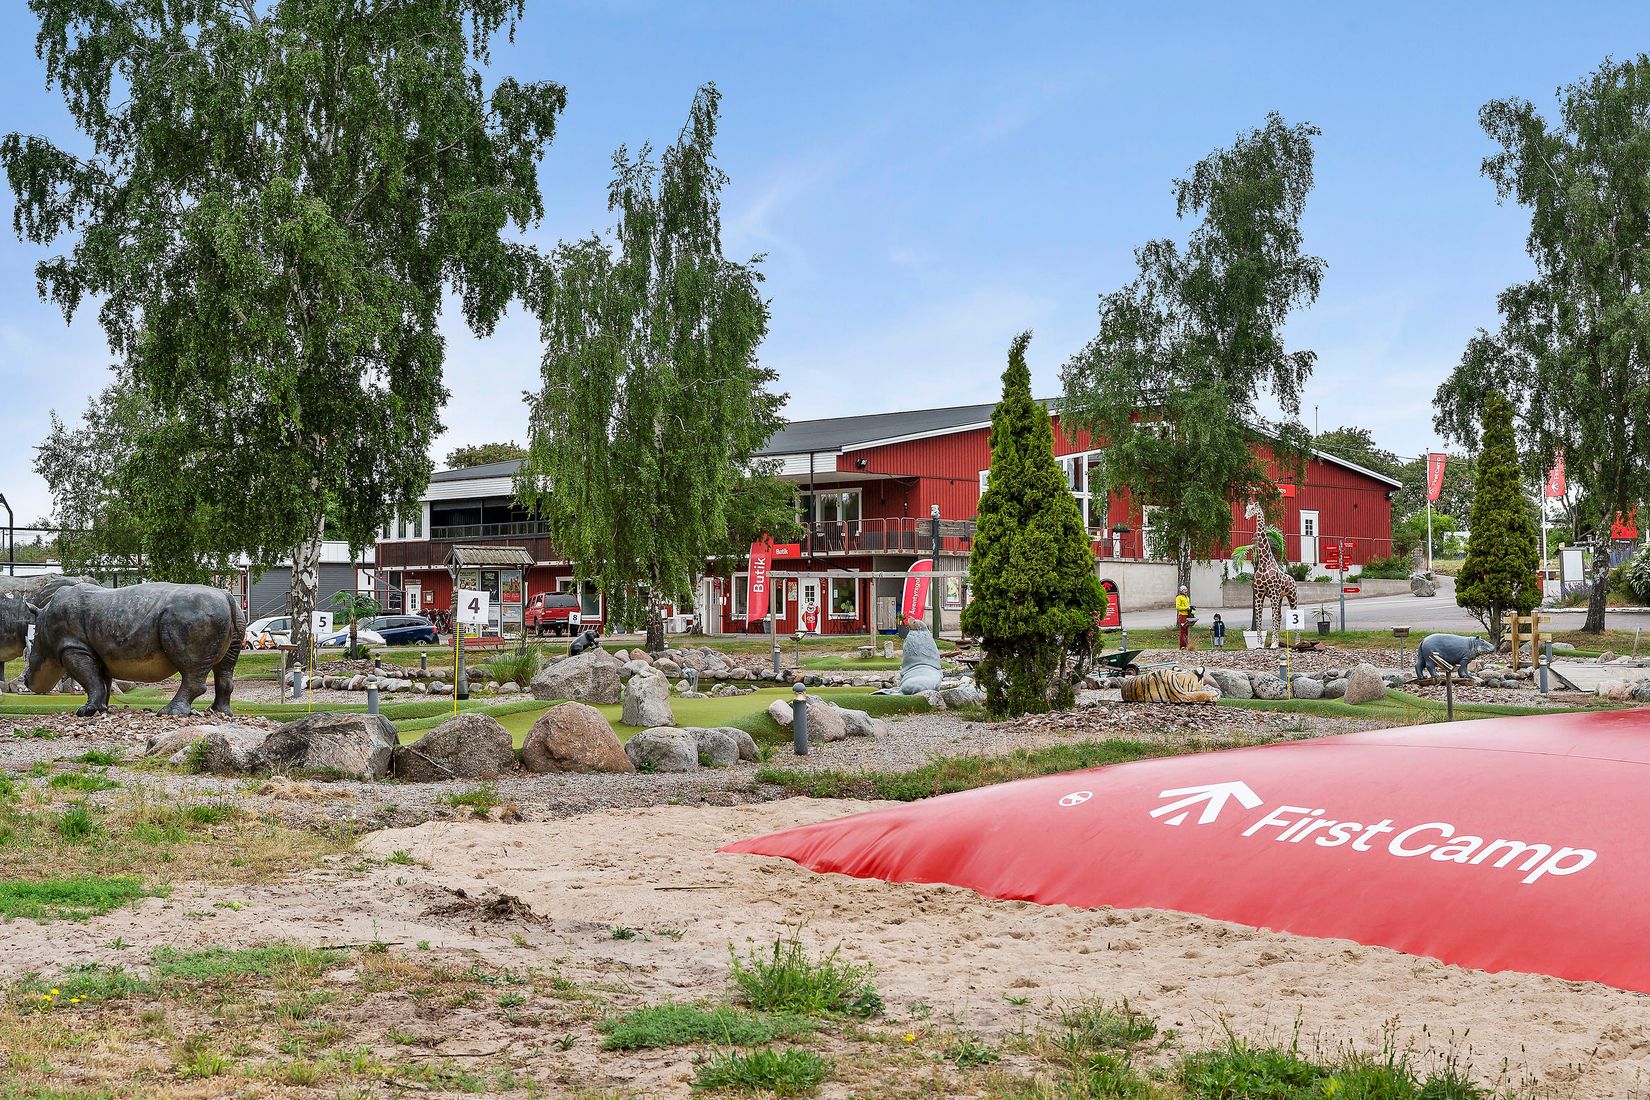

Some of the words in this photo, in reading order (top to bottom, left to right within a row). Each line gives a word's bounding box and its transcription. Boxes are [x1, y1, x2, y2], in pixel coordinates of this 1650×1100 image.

[753, 557, 766, 593] Butik
[467, 597, 480, 614] 4
[909, 577, 921, 615] Äventyrsgol
[318, 616, 327, 628] 5
[1292, 614, 1299, 624] 3
[1241, 805, 1395, 852] First
[1387, 822, 1598, 885] Camp
